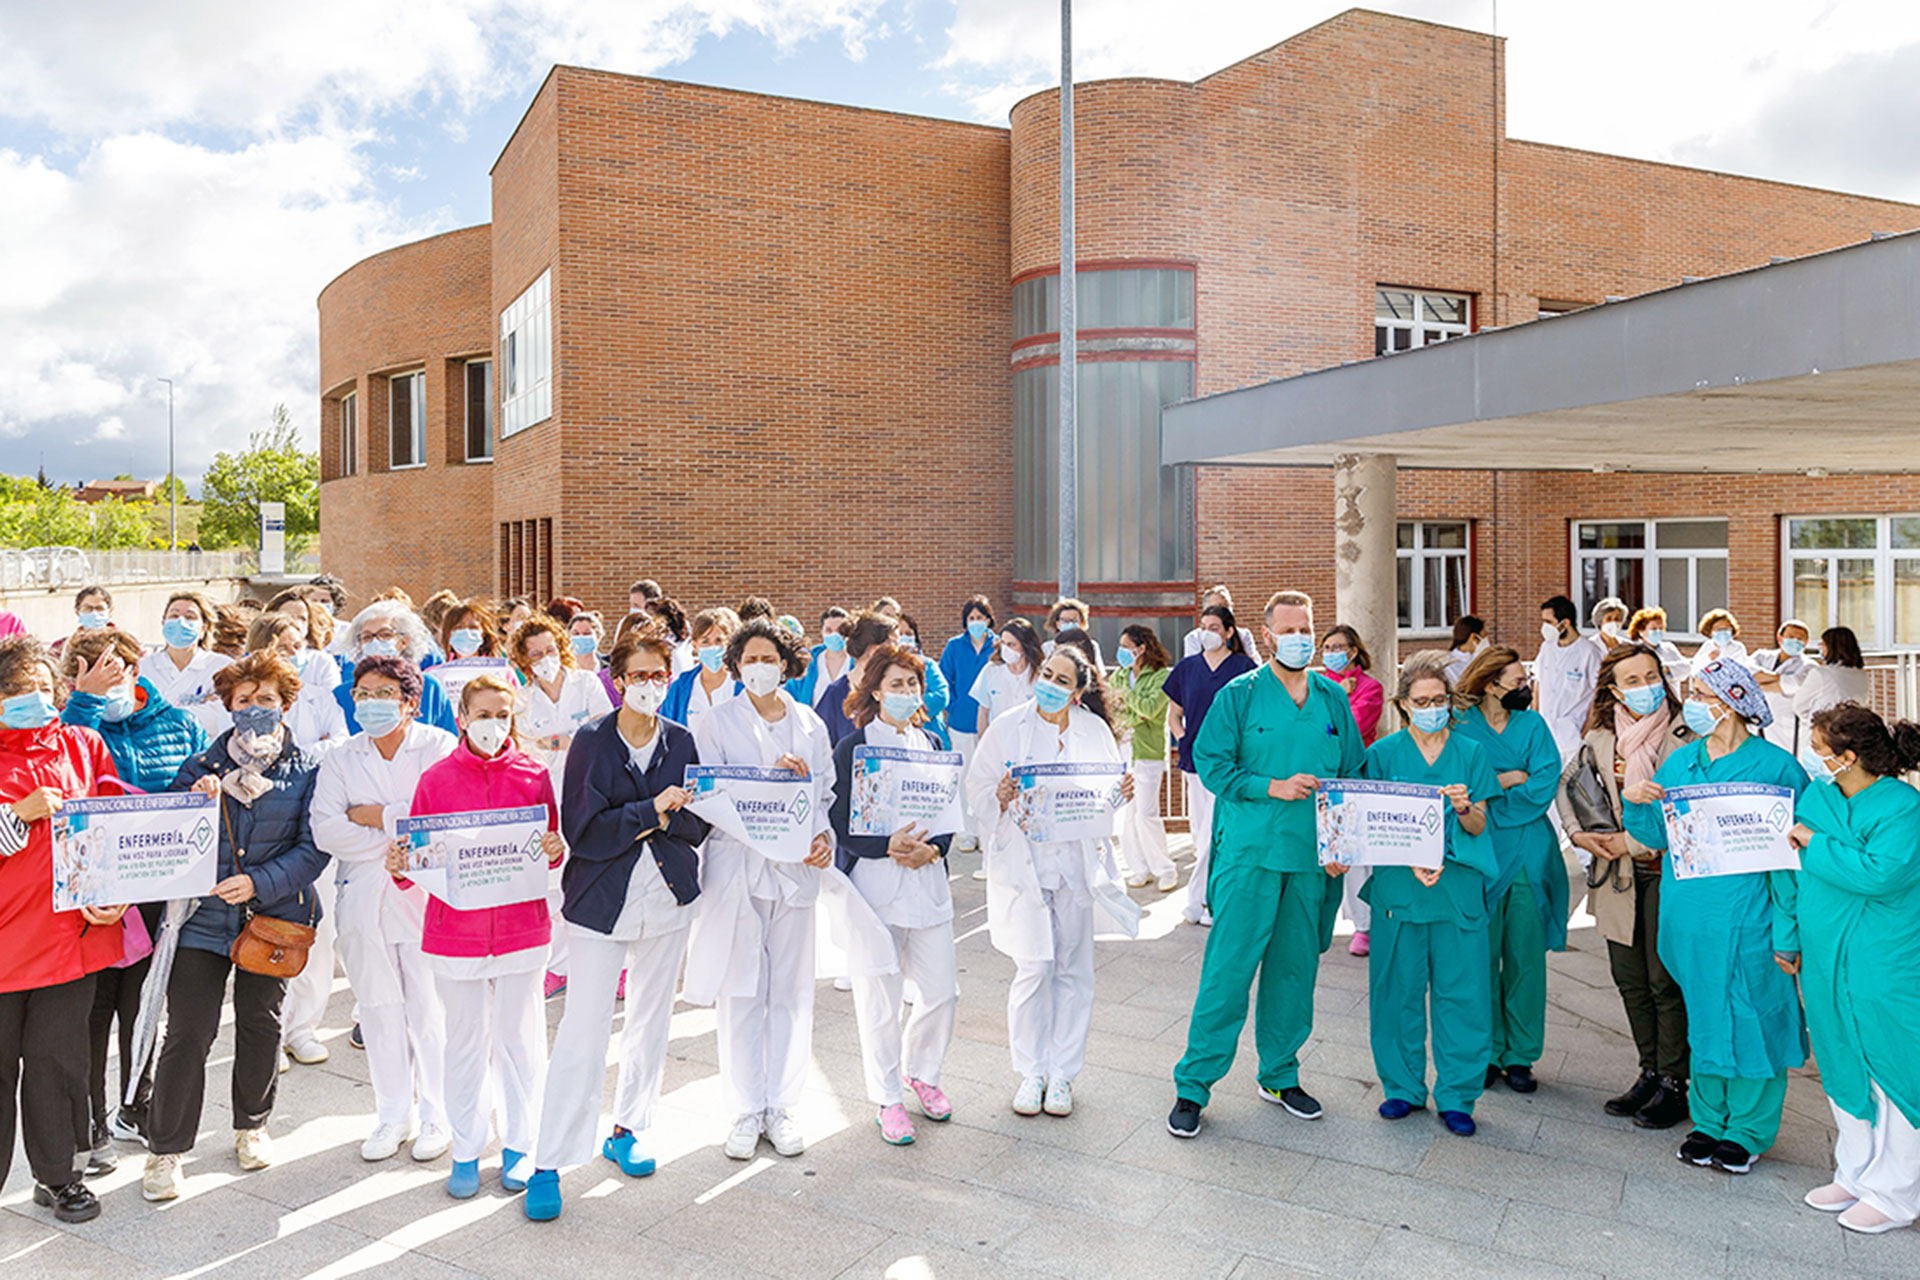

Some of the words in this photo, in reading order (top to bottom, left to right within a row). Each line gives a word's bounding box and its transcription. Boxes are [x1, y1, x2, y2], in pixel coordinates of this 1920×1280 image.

[1367, 810, 1416, 824] ENFERMERÍA
[118, 832, 184, 850] ENFERMERÍA
[459, 843, 518, 860] ENFERMERÍA
